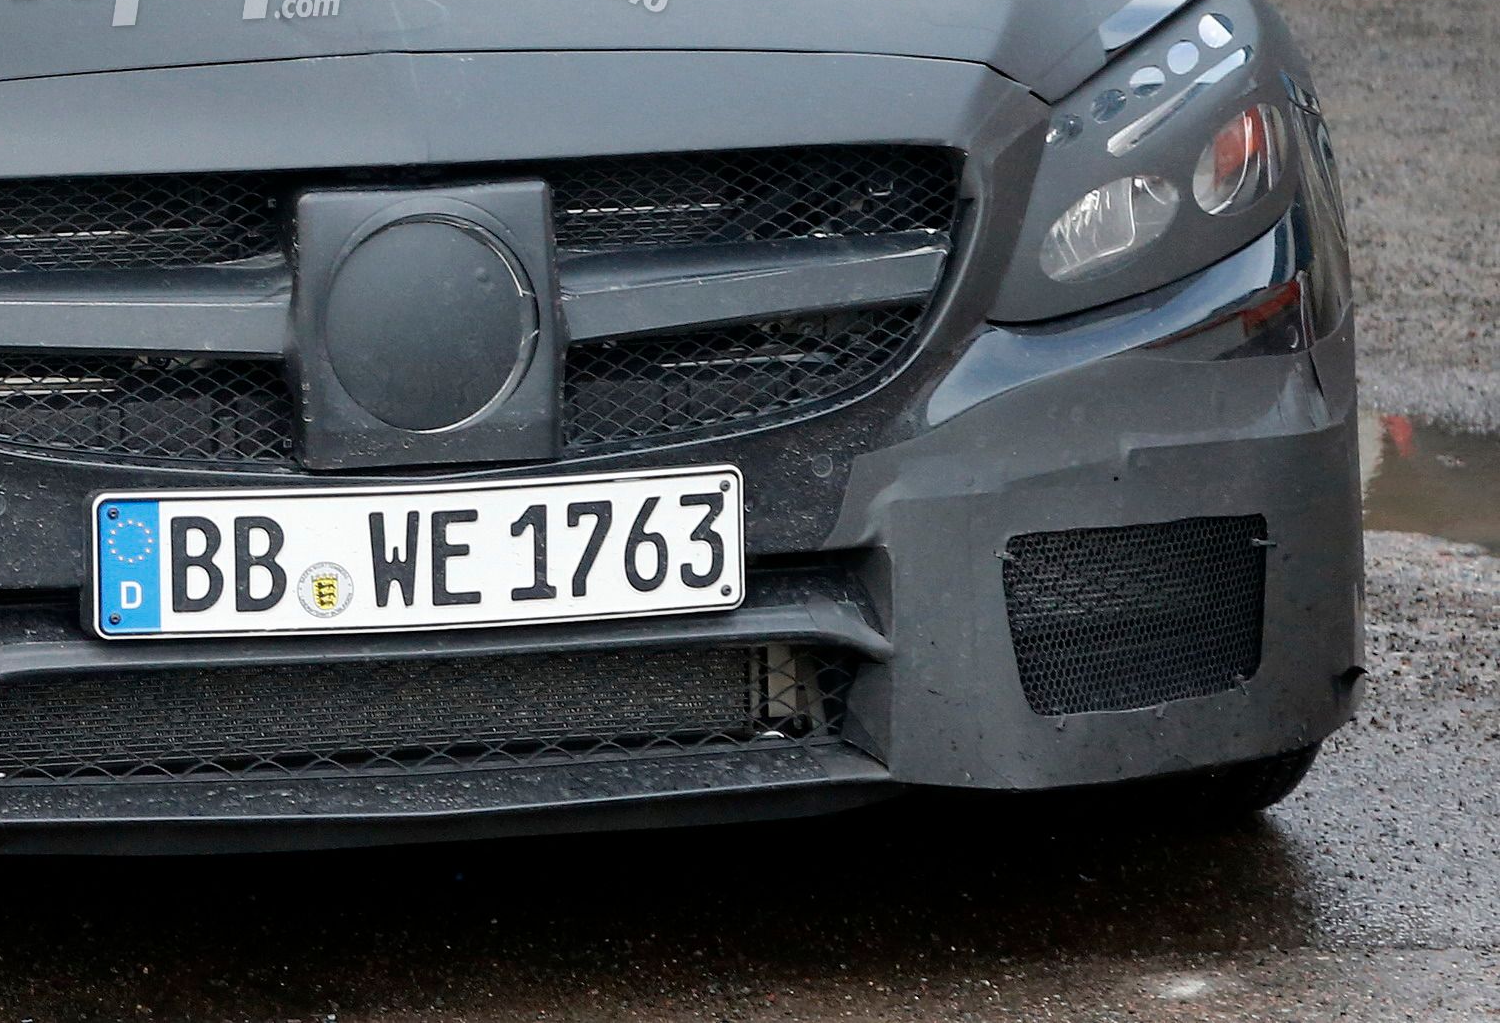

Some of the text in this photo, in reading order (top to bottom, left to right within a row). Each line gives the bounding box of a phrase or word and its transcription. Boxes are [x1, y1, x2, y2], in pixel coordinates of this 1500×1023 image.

[169, 515, 288, 614] BB
[368, 507, 482, 609] WE
[509, 492, 726, 602] 1763
[120, 580, 143, 610] D
